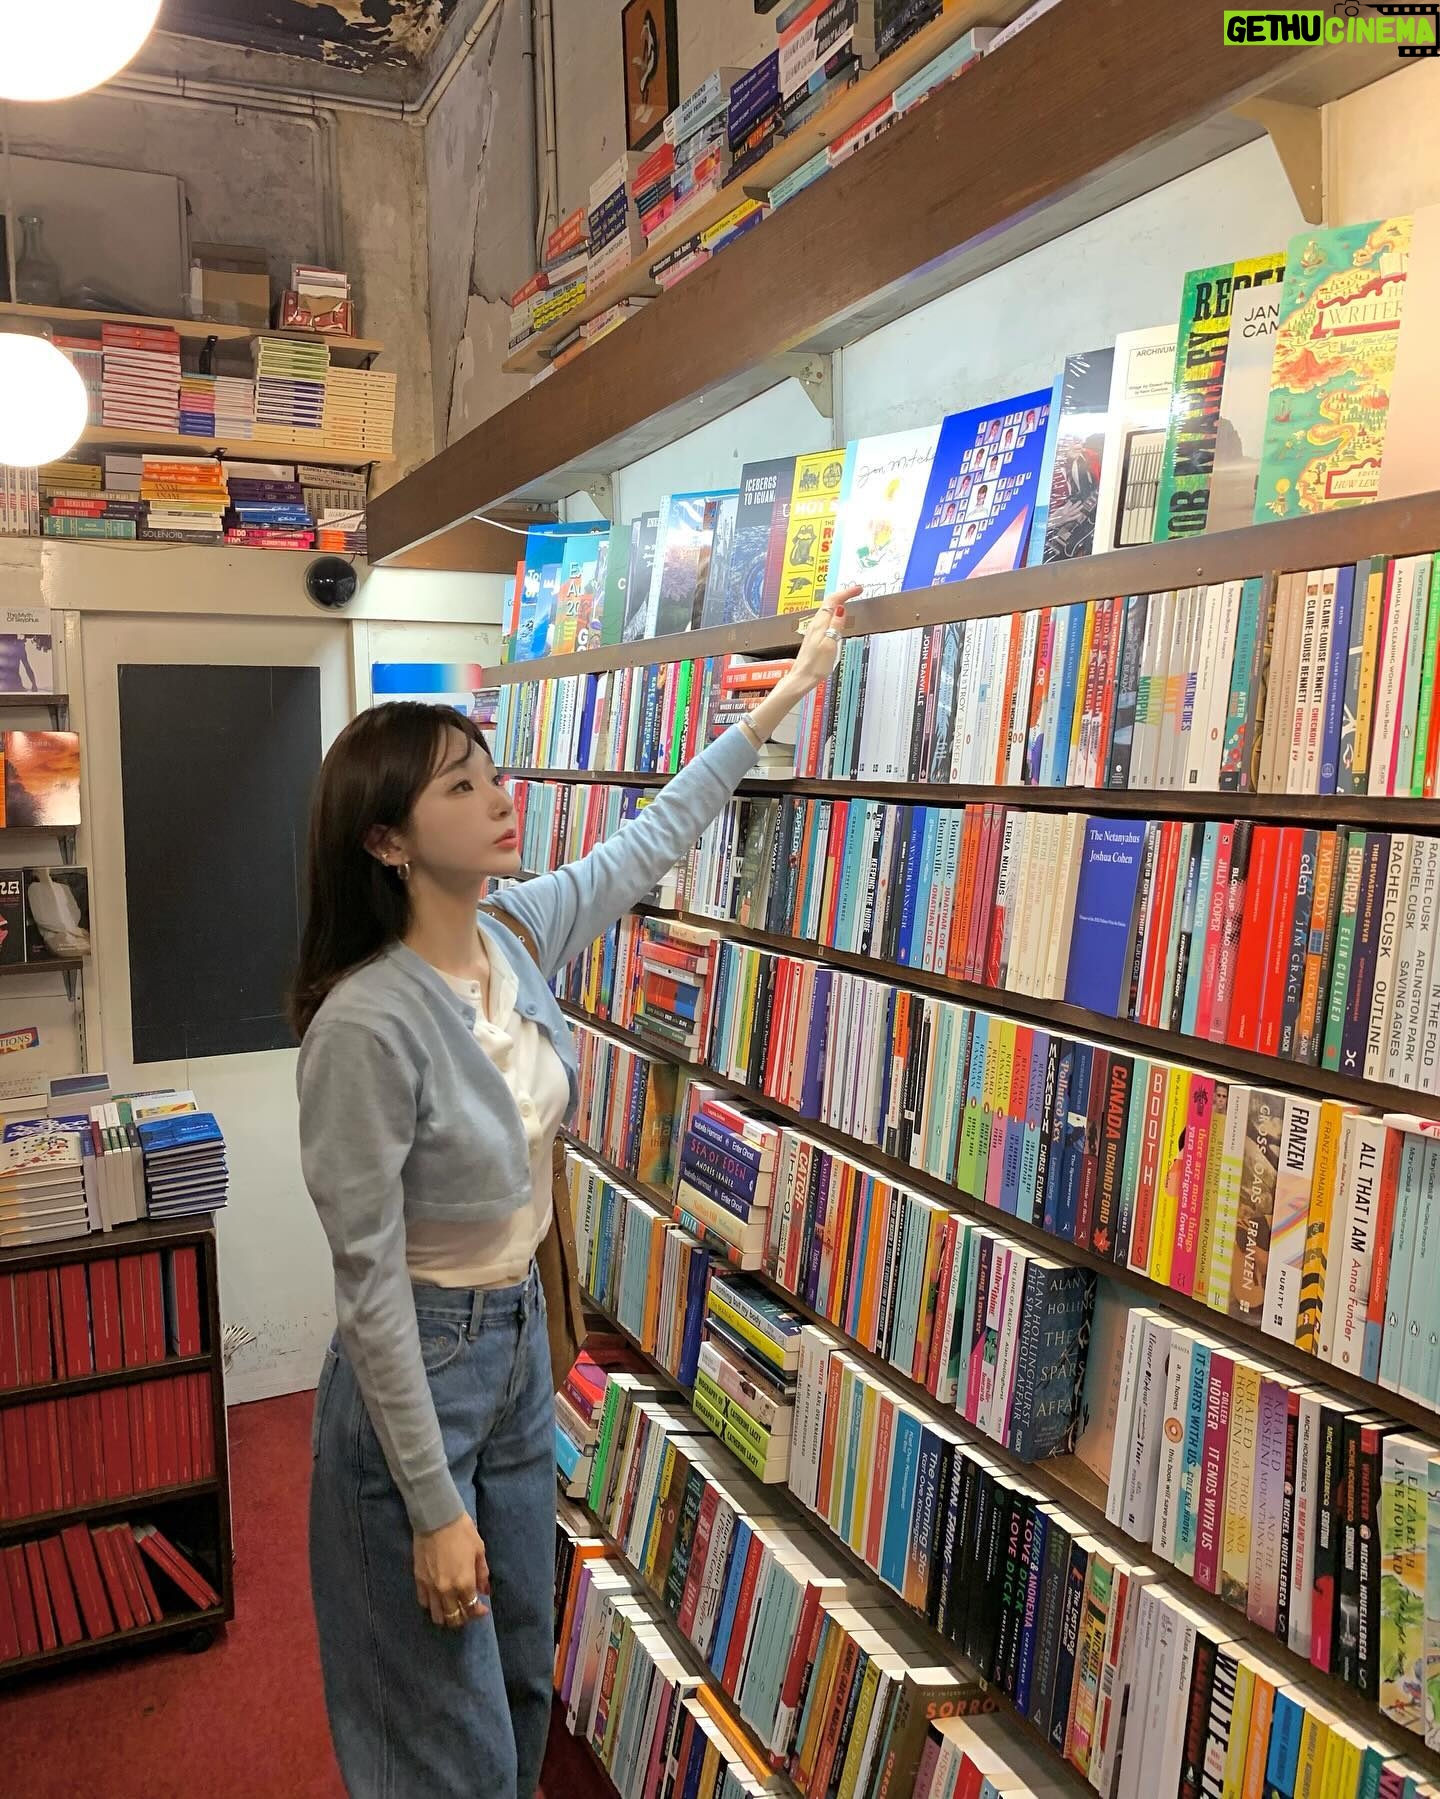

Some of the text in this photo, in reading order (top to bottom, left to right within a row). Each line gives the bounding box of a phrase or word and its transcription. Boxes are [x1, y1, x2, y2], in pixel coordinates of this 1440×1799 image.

[745, 475, 777, 492] ICEBERGS
[745, 493, 752, 505] TO
[922, 634, 931, 660] JOHN
[917, 663, 928, 707] BANVILLE
[1135, 676, 1150, 724] MURPHY
[1181, 672, 1197, 731] MALONE DIES
[1237, 691, 1246, 718] AFTER
[1292, 599, 1317, 761] CLAIRE-LOUISE BENNETT CHECKOUT 19
[1308, 599, 1332, 762] CLAIRE-LOUISE BENNETT CHECKOUT 19
[792, 806, 803, 856] PAPILLON
[933, 818, 947, 877] Bournville
[1089, 829, 1141, 846] The Netanyahus
[863, 813, 884, 932] Tice Cin KEEPING THE HOUSE
[998, 820, 1014, 895] TERRA NULLIUS
[1089, 850, 1133, 864] Joshua Cohen
[928, 883, 938, 927] JONATHAN
[938, 820, 959, 951] Bournville JONATHAN COE
[1195, 855, 1210, 928] JILLY COOPER
[1287, 854, 1313, 1003] eden JIM CRACE
[1368, 841, 1404, 1054] RACHEL CUSK OUTLINE
[1390, 840, 1424, 1057] RACHEL CUSK SAVING AGNES
[1404, 843, 1438, 1062] RACHEL CUSK ARLINGTON PARK
[1034, 1043, 1057, 1204] MAMMOTH CHRIS FLYNN
[1098, 1065, 1127, 1225] CANADA RICHARD FORD
[1287, 1106, 1310, 1171] FRANZEN
[690, 1138, 707, 1157] SEA
[722, 1157, 746, 1180] EDEN
[1360, 1142, 1376, 1169] ALL
[1176, 1125, 1196, 1249] yara rodrigues fowler
[1185, 1127, 1206, 1254] there are more things
[1356, 1173, 1373, 1215] THAT
[1350, 1227, 1367, 1252] AM
[1050, 1280, 1080, 1291] ALAN
[1273, 1270, 1286, 1310] PURITY
[1348, 1260, 1363, 1292] Anna
[1013, 1267, 1037, 1420] THE SPARSHOLT AFFAIR
[1044, 1330, 1073, 1347] THE
[1343, 1295, 1360, 1342] Funder
[1022, 1270, 1045, 1429] ALAN HOLLINGHURST
[1191, 1367, 1205, 1414] STARTS
[1207, 1376, 1222, 1431] HOOVER
[1219, 1390, 1230, 1424] COLLEEN
[1231, 1374, 1246, 1446] HOSSEINI
[1243, 1378, 1256, 1450] KHALED
[720, 1418, 727, 1441] X
[747, 1450, 759, 1468] LACEY
[1188, 1415, 1201, 1447] WITH
[1260, 1394, 1273, 1468] HOSSEINI
[1270, 1398, 1284, 1473] KHALED
[1302, 1414, 1311, 1442] MICHEL
[1186, 1449, 1198, 1468] US
[1205, 1463, 1218, 1496] ENDS
[1300, 1444, 1309, 1494] HOUELLEBECQ
[911, 1452, 928, 1562] Karl Ove Knausgaard
[1183, 1471, 1195, 1508] COLLEEN
[1226, 1449, 1241, 1554] SPLENDID SUNS
[1320, 1426, 1333, 1549] MICHEL HOUELLEBECQ SEROTONIN
[916, 1452, 938, 1584] The Morning Star
[1181, 1510, 1193, 1544] HOOVER
[1202, 1499, 1216, 1529] WITH
[1236, 1474, 1249, 1554] THOUSAND
[1281, 1498, 1291, 1535] MICHEL
[1392, 1458, 1405, 1576] JANE HOWARD
[1405, 1475, 1418, 1569] ELIZABETH
[713, 1513, 732, 1585] Hilary Mantel
[1021, 1519, 1034, 1569] LOVE
[1201, 1531, 1214, 1551] US
[1014, 1569, 1028, 1614] DICK
[1278, 1537, 1289, 1606] HOUELLEBECQ
[1294, 1556, 1304, 1591] TERRITORY
[1209, 1651, 1238, 1753] WHITE
